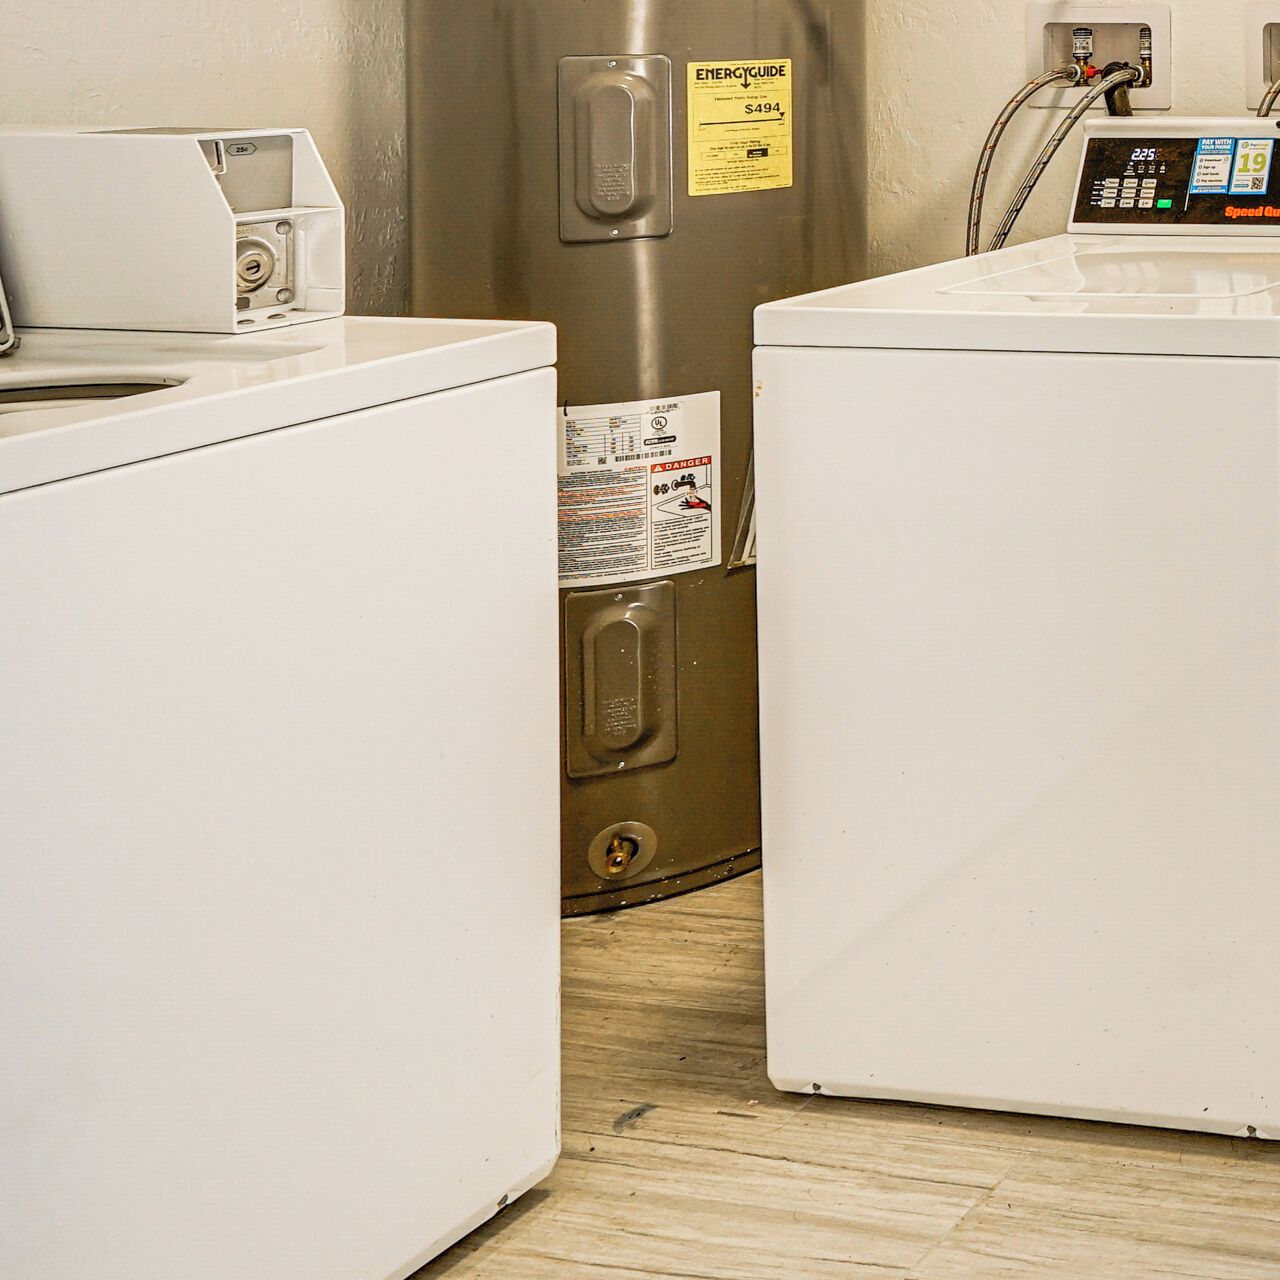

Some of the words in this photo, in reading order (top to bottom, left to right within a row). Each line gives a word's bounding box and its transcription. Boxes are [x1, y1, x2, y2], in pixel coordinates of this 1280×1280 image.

[696, 65, 786, 81] ENERGYGUIDE
[745, 102, 780, 114] $494
[1238, 153, 1266, 173] 19
[1224, 206, 1263, 218] Speed
[666, 458, 708, 470] DANGER
